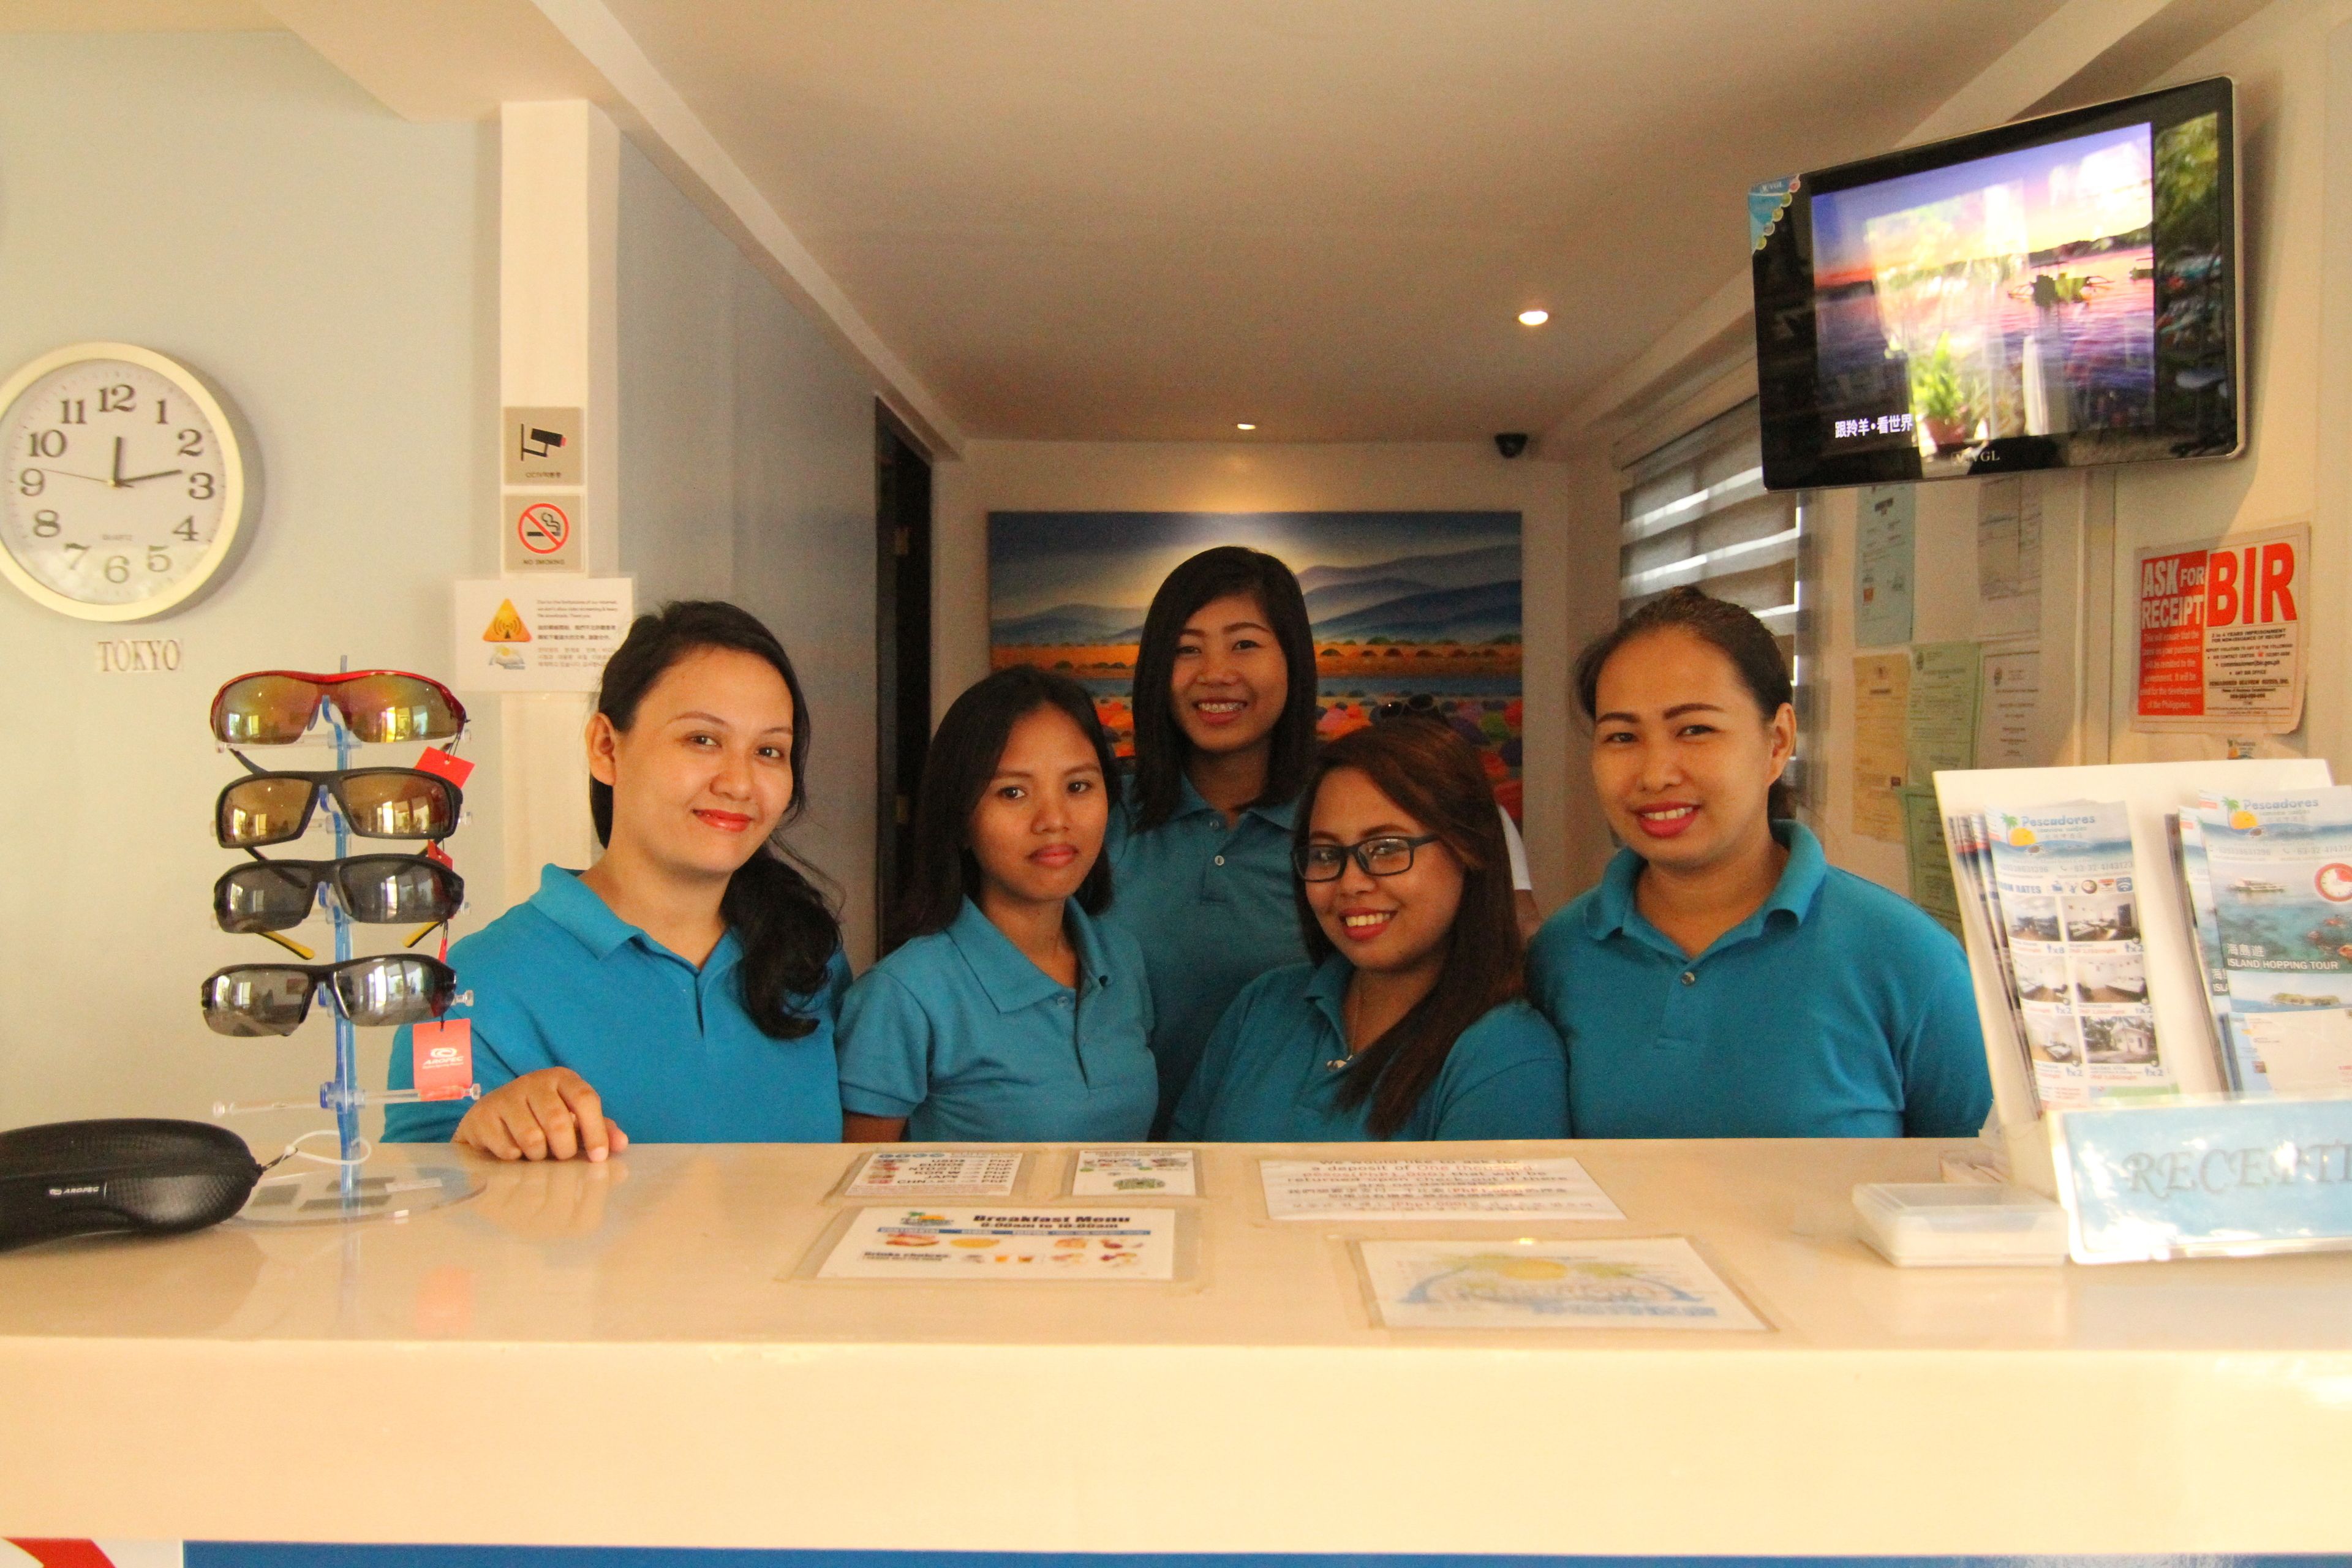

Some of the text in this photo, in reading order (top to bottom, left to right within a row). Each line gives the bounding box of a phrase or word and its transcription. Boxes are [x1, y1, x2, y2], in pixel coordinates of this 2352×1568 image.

[61, 399, 87, 424] 11
[98, 384, 137, 412] 12
[156, 400, 168, 424] 1
[29, 430, 68, 457] 10
[177, 429, 203, 457] 2
[20, 469, 45, 496] 9
[189, 472, 214, 499] 3
[32, 510, 61, 538] 8
[173, 515, 199, 541] 4
[64, 543, 90, 570] 7
[104, 556, 130, 584] 6
[147, 545, 172, 572] 5
[2143, 559, 2204, 598] ASK FOR
[2207, 542, 2297, 627] BIR
[2141, 595, 2204, 630] RECEIPT
[98, 640, 181, 671] TOKYO
[2243, 798, 2319, 810] Pescadores
[2021, 815, 2095, 827] Pescadores
[2016, 883, 2041, 894] RATES
[2227, 958, 2338, 970] ISLAND HOPPING TOUR
[423, 1056, 464, 1065] AROPEC
